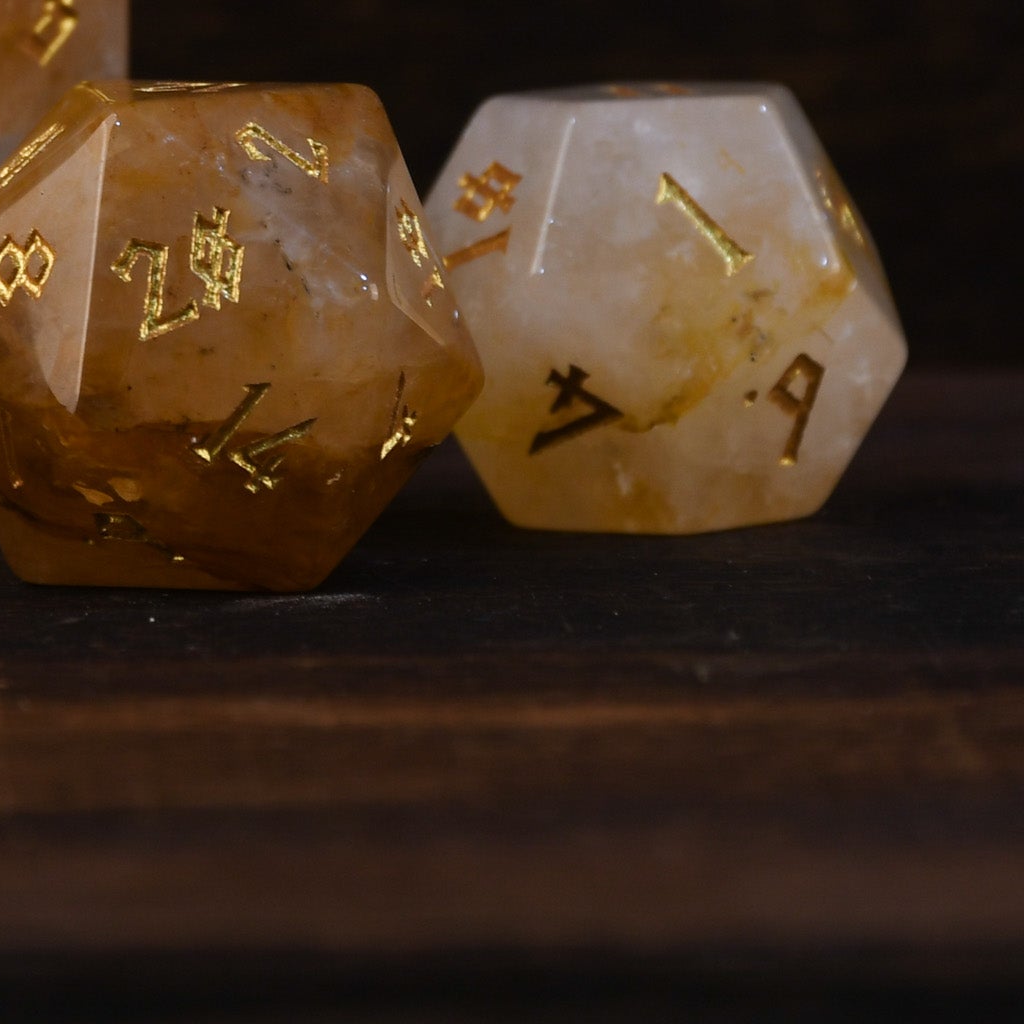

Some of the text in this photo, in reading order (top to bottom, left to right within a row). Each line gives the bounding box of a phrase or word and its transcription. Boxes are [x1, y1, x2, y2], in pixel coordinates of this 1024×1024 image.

[236, 121, 329, 185] 2
[656, 172, 754, 276] 1
[110, 205, 245, 342] 20
[530, 364, 626, 456] 4
